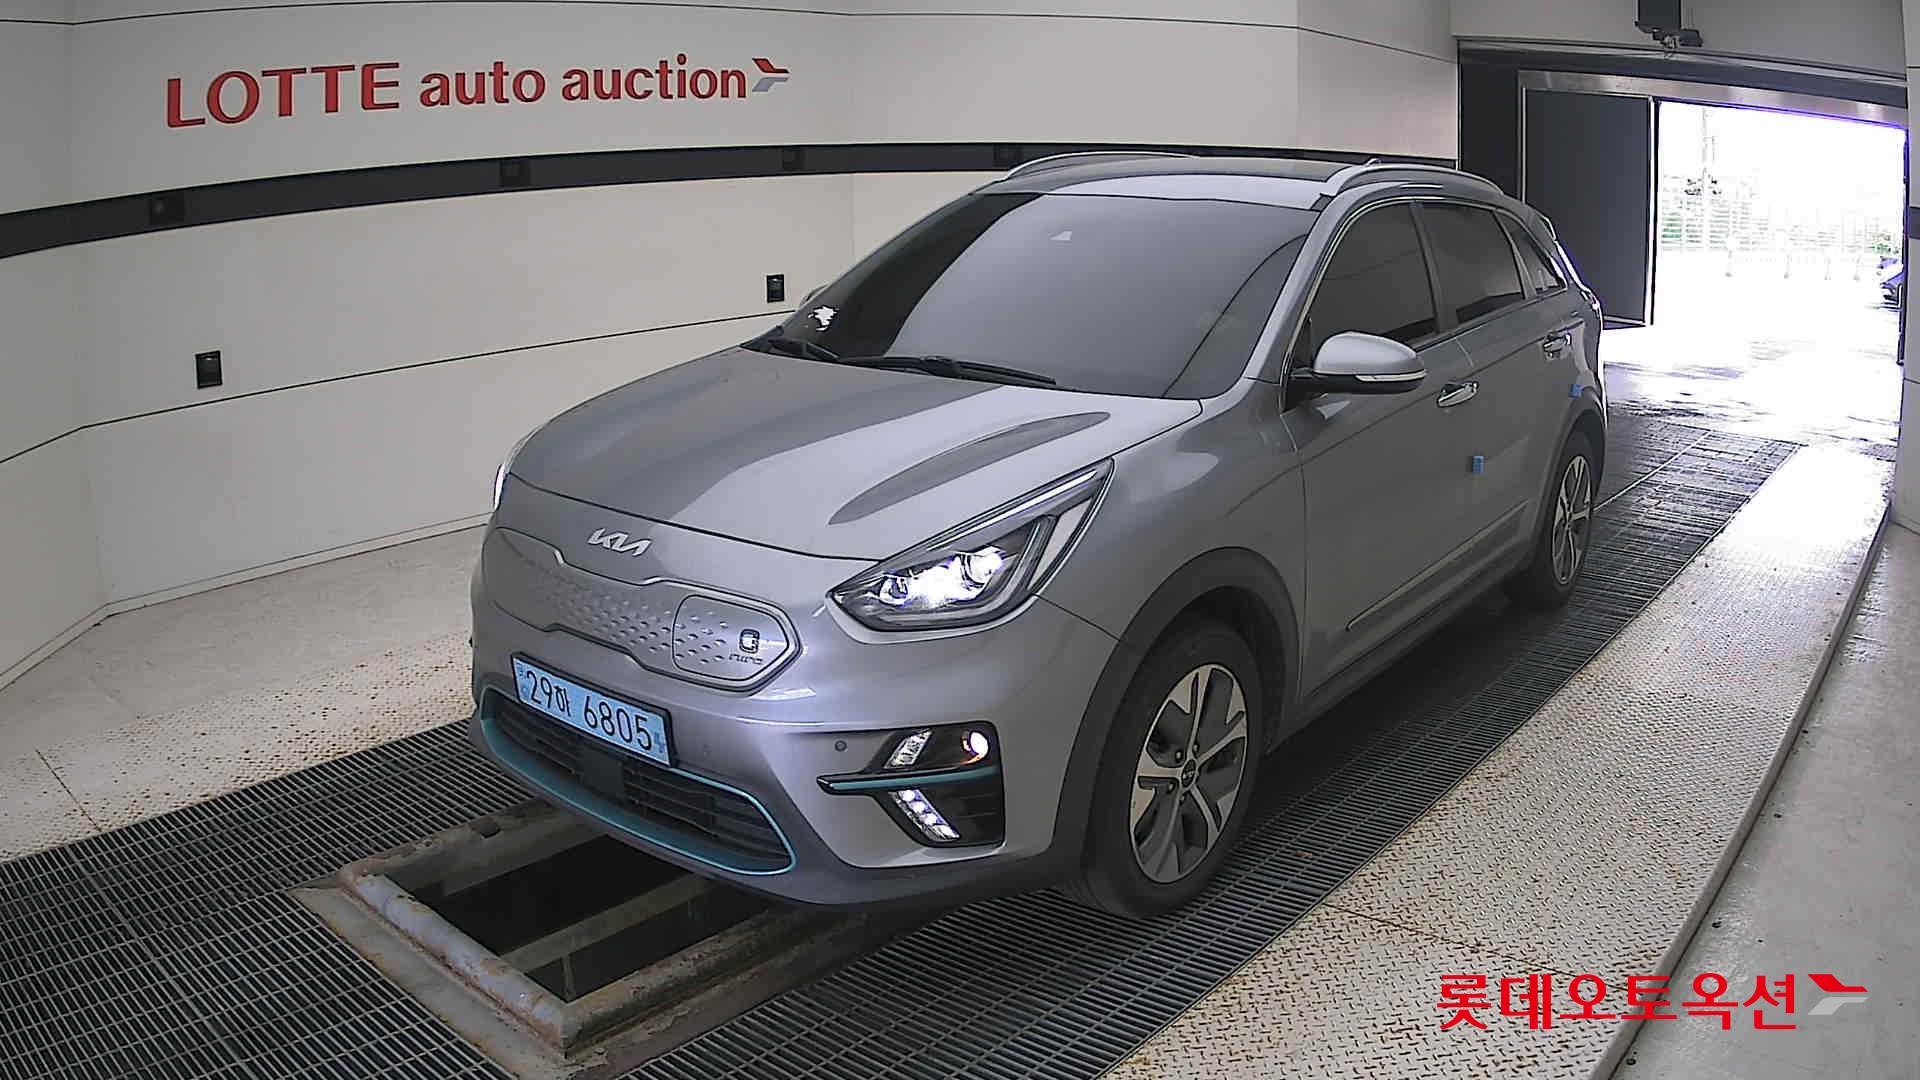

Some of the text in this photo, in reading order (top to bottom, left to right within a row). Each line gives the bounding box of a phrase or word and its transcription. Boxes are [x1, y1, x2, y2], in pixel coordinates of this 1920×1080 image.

[166, 53, 748, 128] LOTTE auto auction
[587, 528, 653, 557] KIA
[583, 696, 653, 751] 6805
